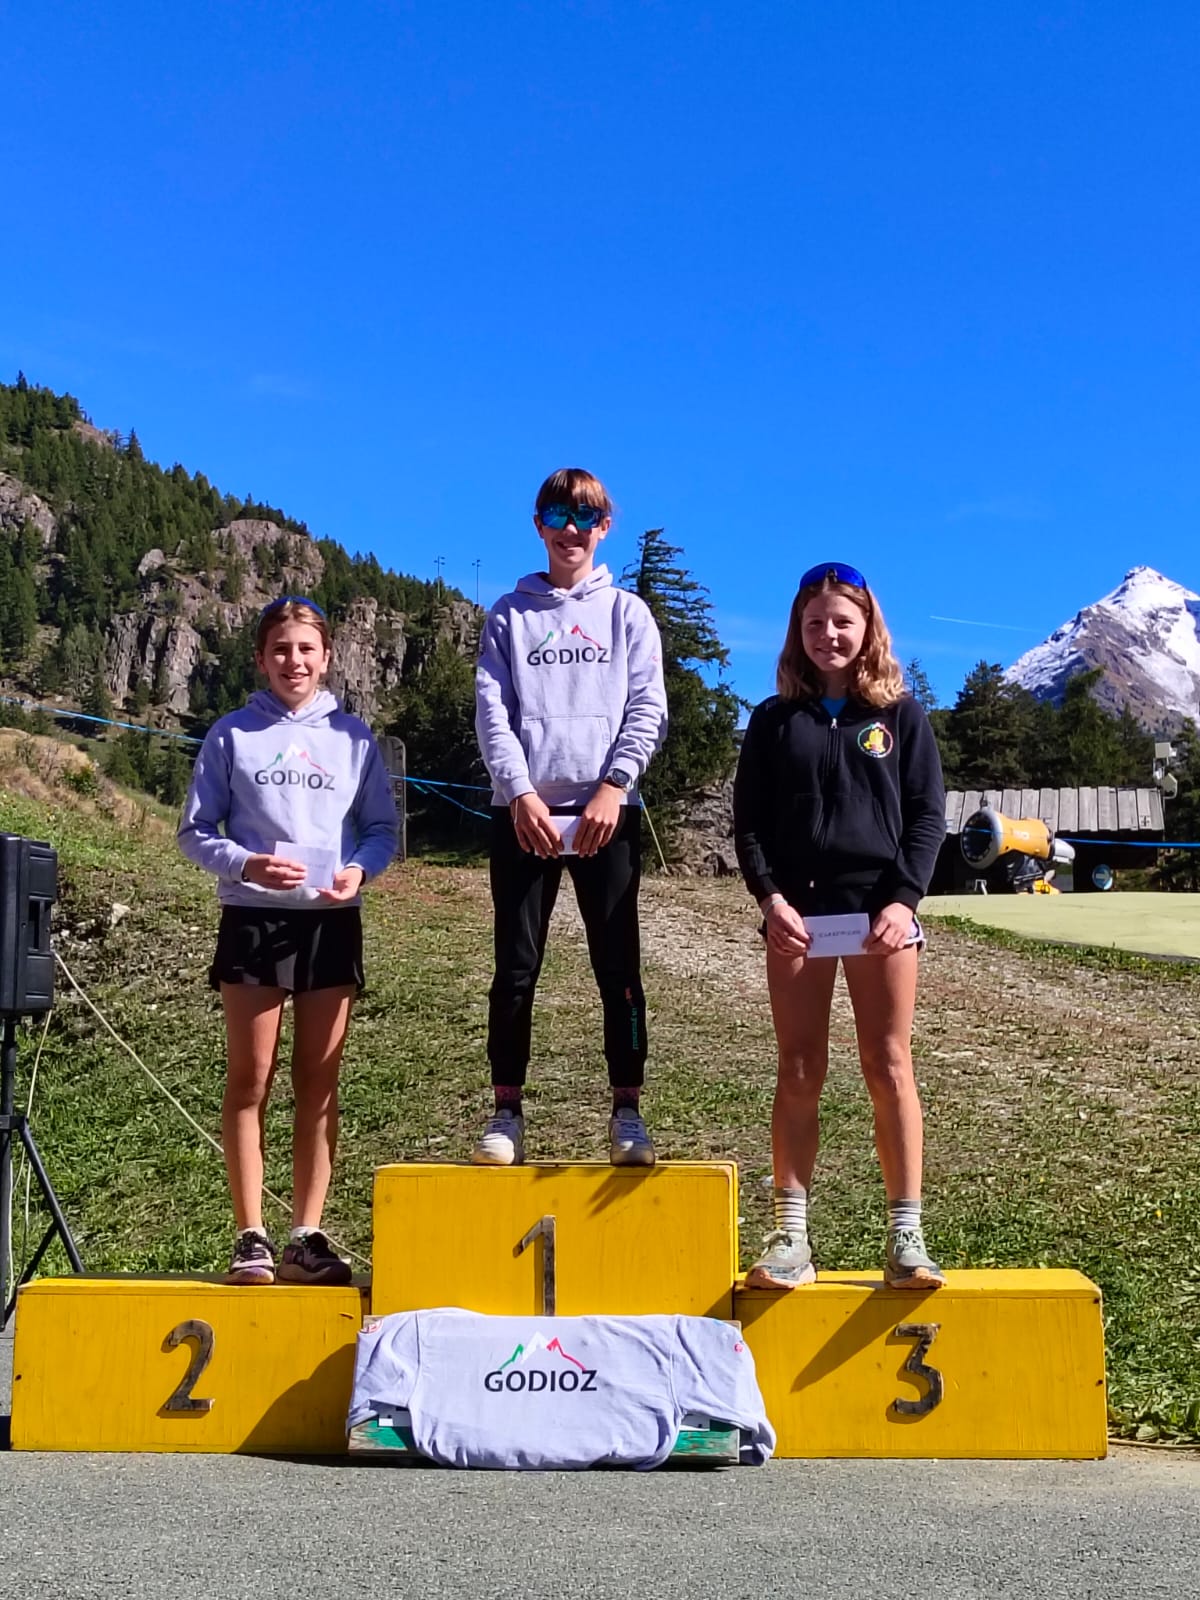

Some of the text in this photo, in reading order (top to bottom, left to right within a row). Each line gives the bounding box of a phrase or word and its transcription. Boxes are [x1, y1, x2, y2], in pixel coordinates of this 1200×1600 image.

[527, 646, 610, 666] GODIOZ
[254, 769, 336, 791] GODIOZ
[520, 1214, 556, 1317] 1
[164, 1318, 216, 1412] 2
[484, 1369, 598, 1393] GODIOZ
[893, 1322, 944, 1416] 3
